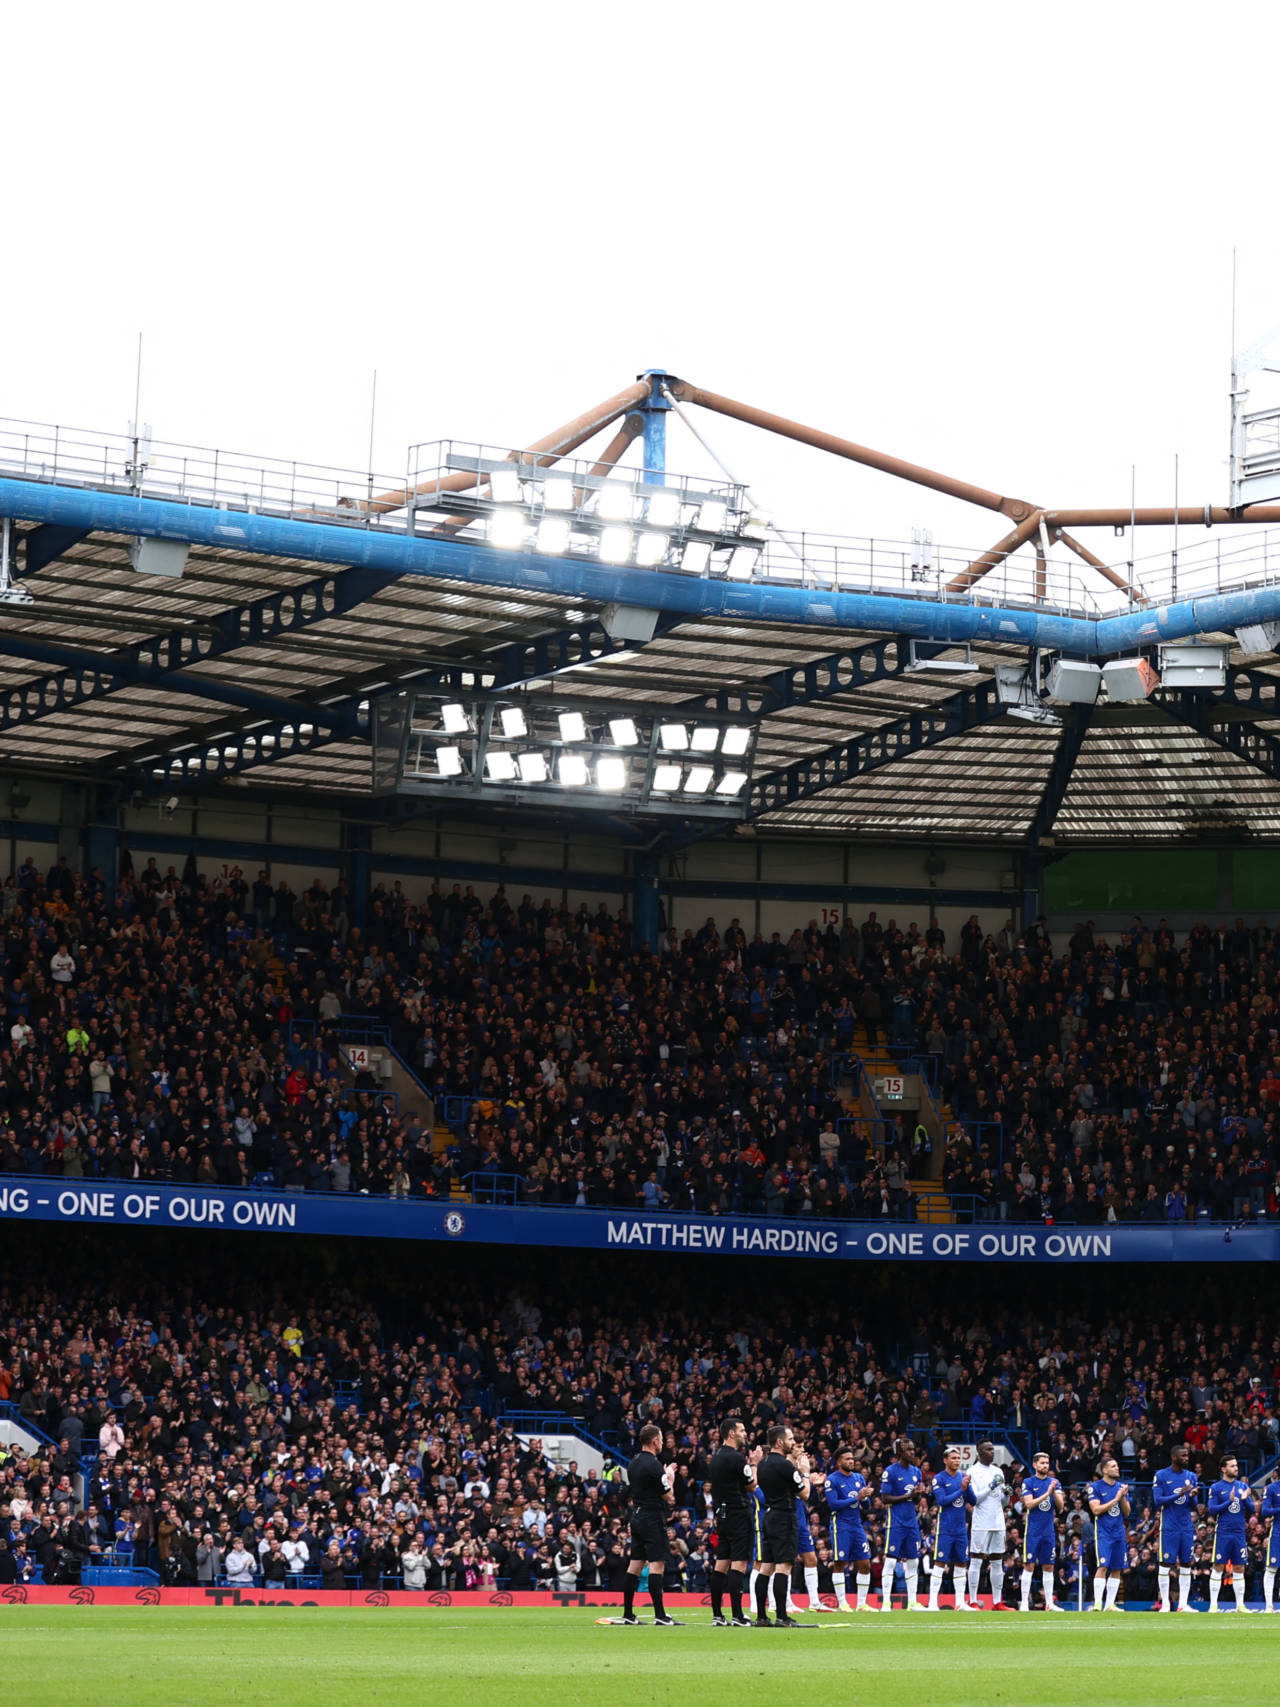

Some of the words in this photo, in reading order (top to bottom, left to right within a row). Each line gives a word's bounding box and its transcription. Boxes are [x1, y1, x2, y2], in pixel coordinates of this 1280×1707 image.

[822, 908, 839, 925] 15
[351, 1050, 366, 1065] 14
[886, 1079, 901, 1093] 15
[58, 1191, 115, 1217] ONE
[123, 1195, 160, 1219] OF
[168, 1197, 224, 1223] OUR
[232, 1201, 296, 1226] OWN
[607, 1221, 726, 1248] MATTHEW
[732, 1227, 838, 1253] HARDING
[866, 1232, 924, 1255] ONE
[932, 1234, 970, 1255] OF
[978, 1234, 1036, 1256] OUR
[1045, 1235, 1111, 1256] OWN
